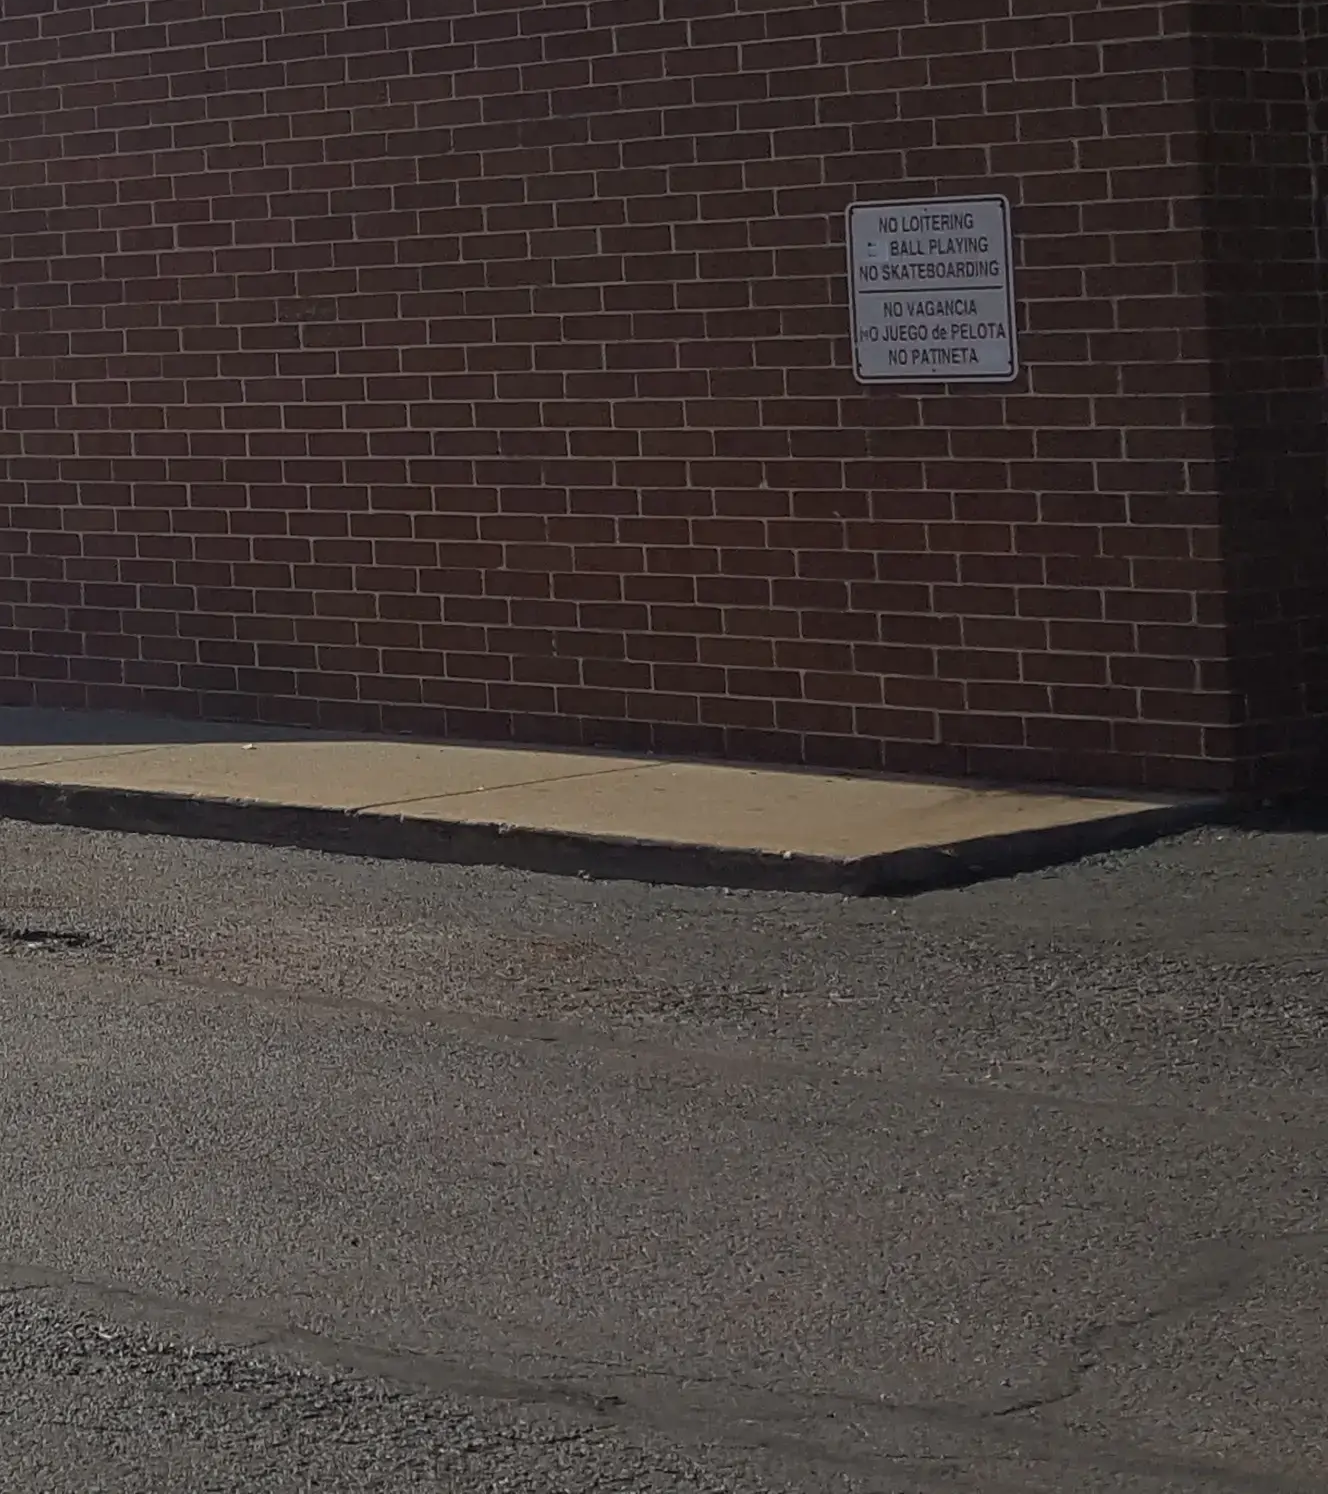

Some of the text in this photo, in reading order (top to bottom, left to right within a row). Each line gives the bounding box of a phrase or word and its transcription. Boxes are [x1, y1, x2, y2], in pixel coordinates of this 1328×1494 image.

[879, 213, 974, 233] NO LOITERING
[890, 240, 925, 256] BALL
[928, 236, 989, 255] PLAYING
[859, 260, 999, 282] NO SKATEBOARDING
[884, 299, 977, 318] NO VAGANCIA
[860, 322, 1006, 342] NO JUEGO de PELOTA
[888, 347, 979, 366] NO PATINETA
